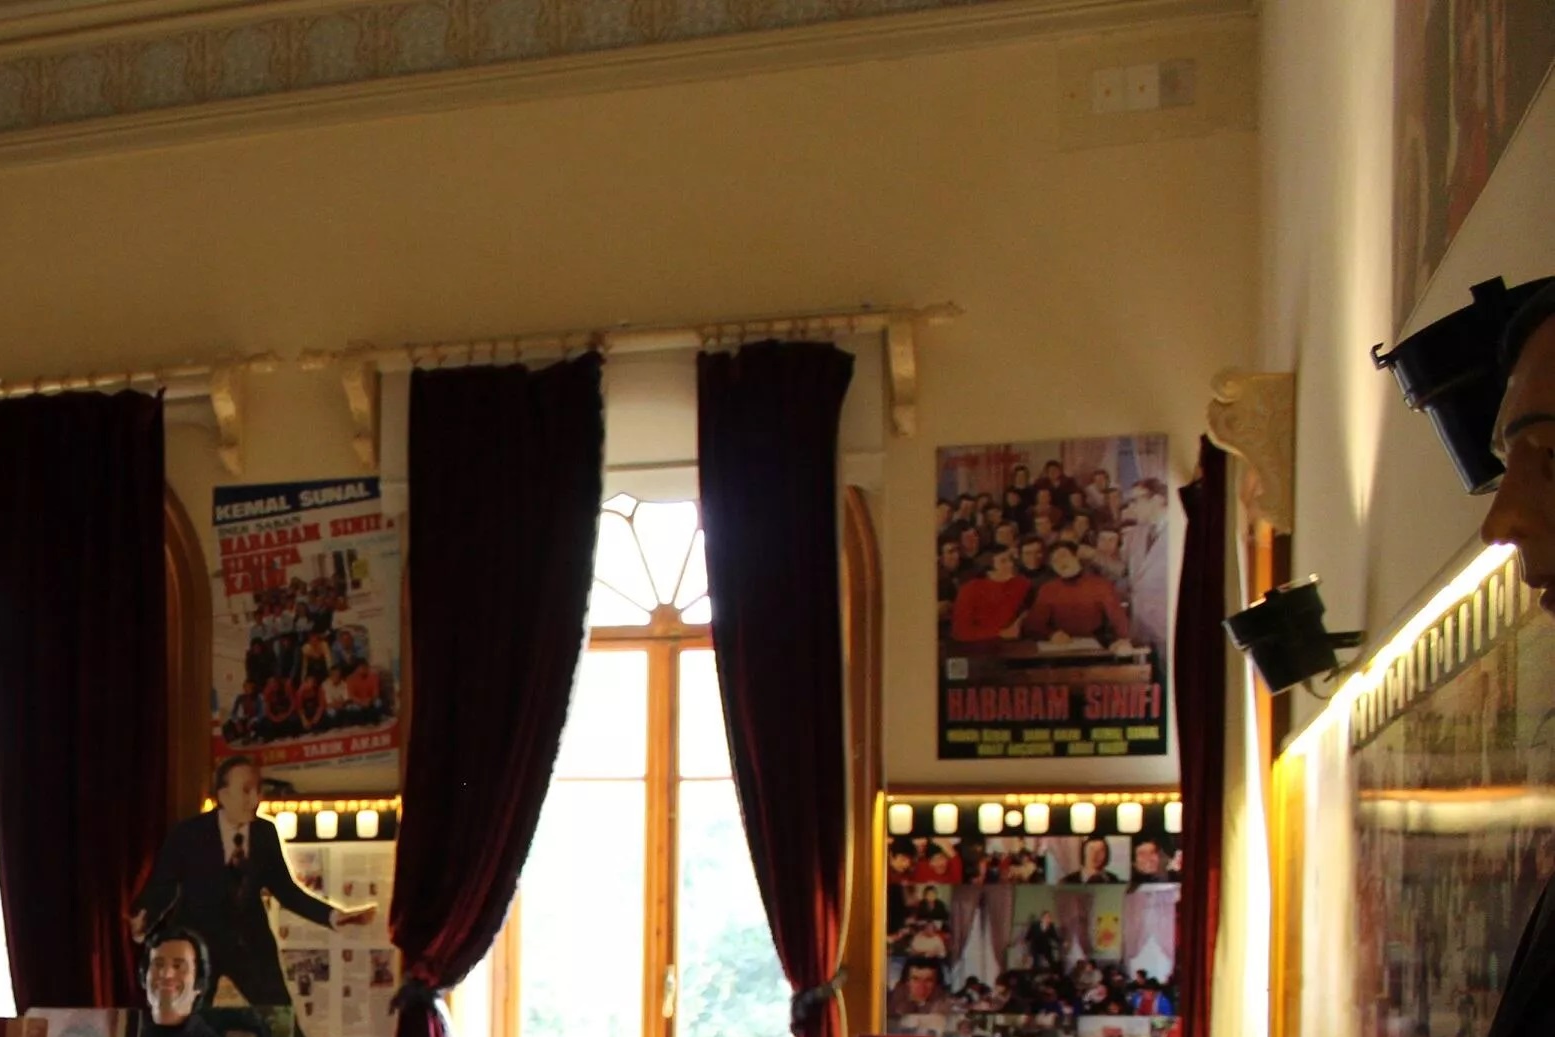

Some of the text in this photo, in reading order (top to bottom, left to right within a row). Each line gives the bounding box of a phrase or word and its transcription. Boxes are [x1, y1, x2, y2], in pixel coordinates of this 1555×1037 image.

[216, 483, 370, 521] KEMAL SUNAL
[947, 682, 1161, 721] HABABAM SINIFI
